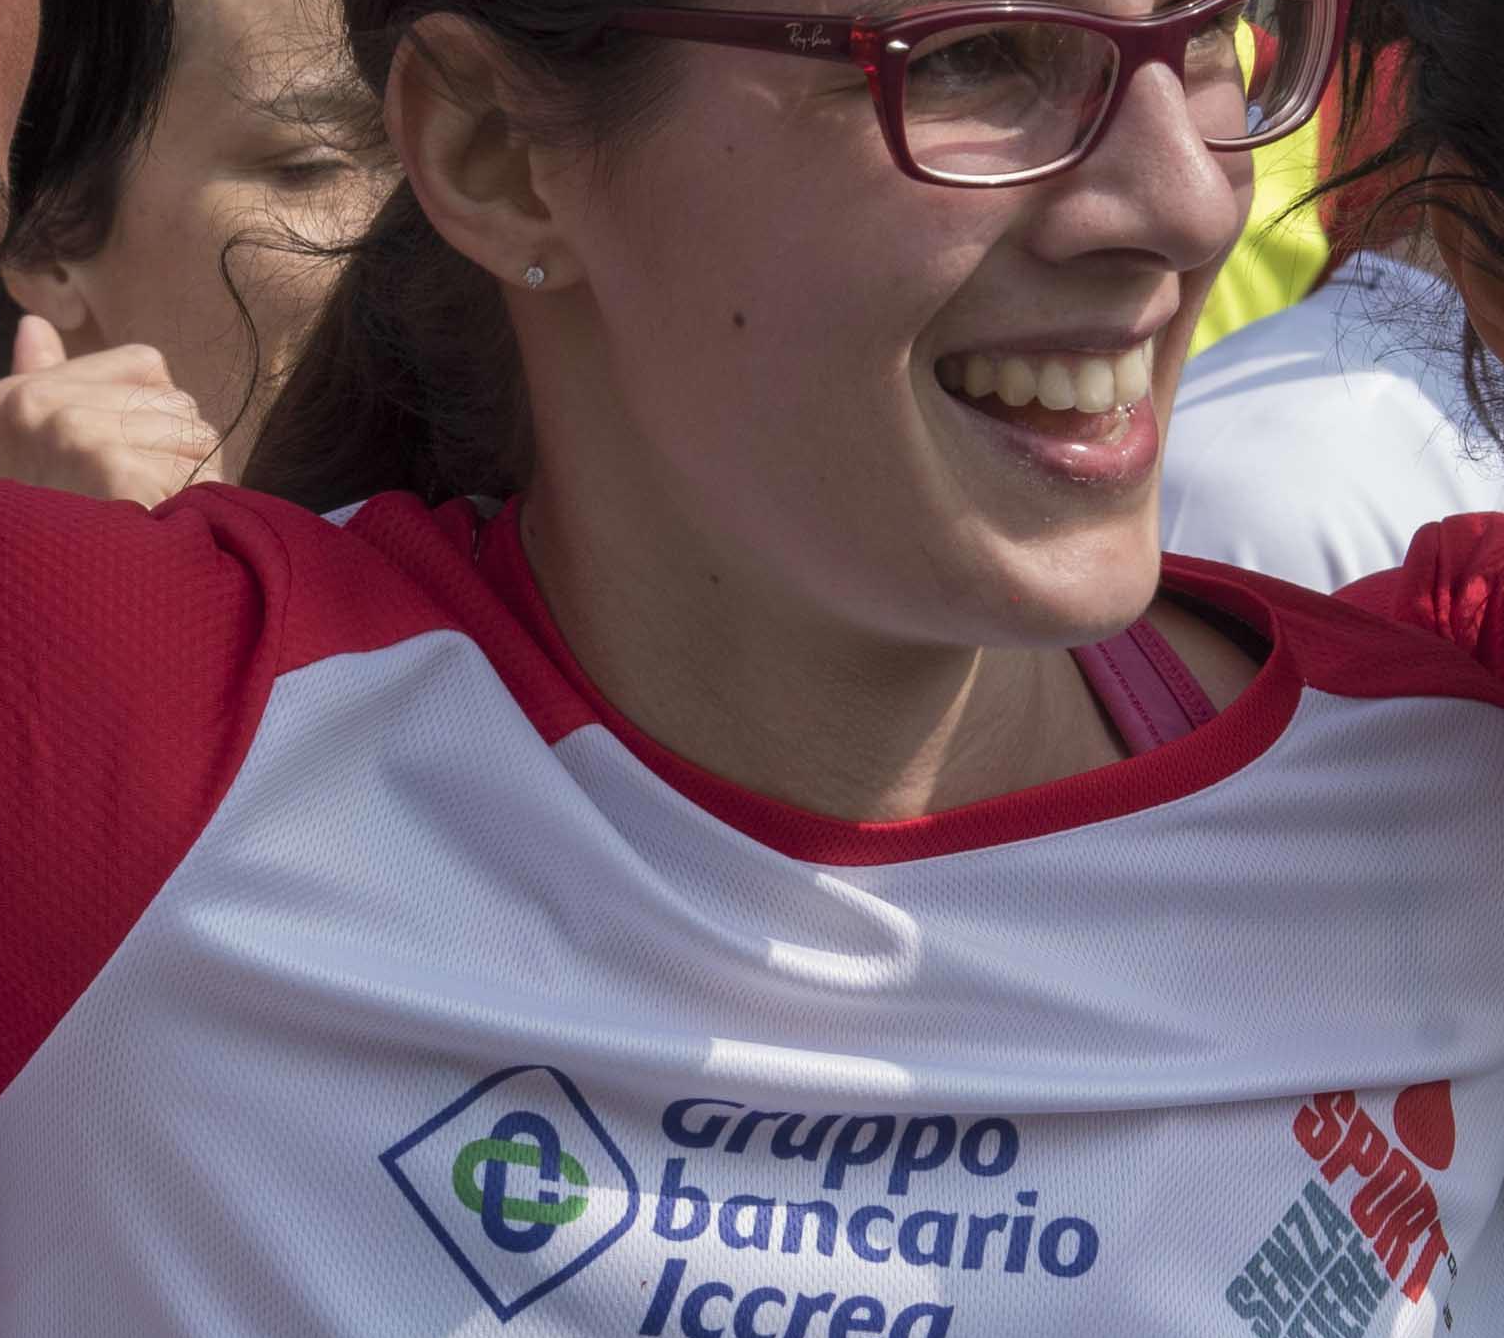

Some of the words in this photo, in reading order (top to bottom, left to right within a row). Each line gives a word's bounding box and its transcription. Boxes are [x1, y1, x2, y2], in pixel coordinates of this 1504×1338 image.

[662, 1098, 1019, 1194] Gruppo
[1293, 1090, 1448, 1304] SPORT
[652, 1159, 1099, 1278] bancario
